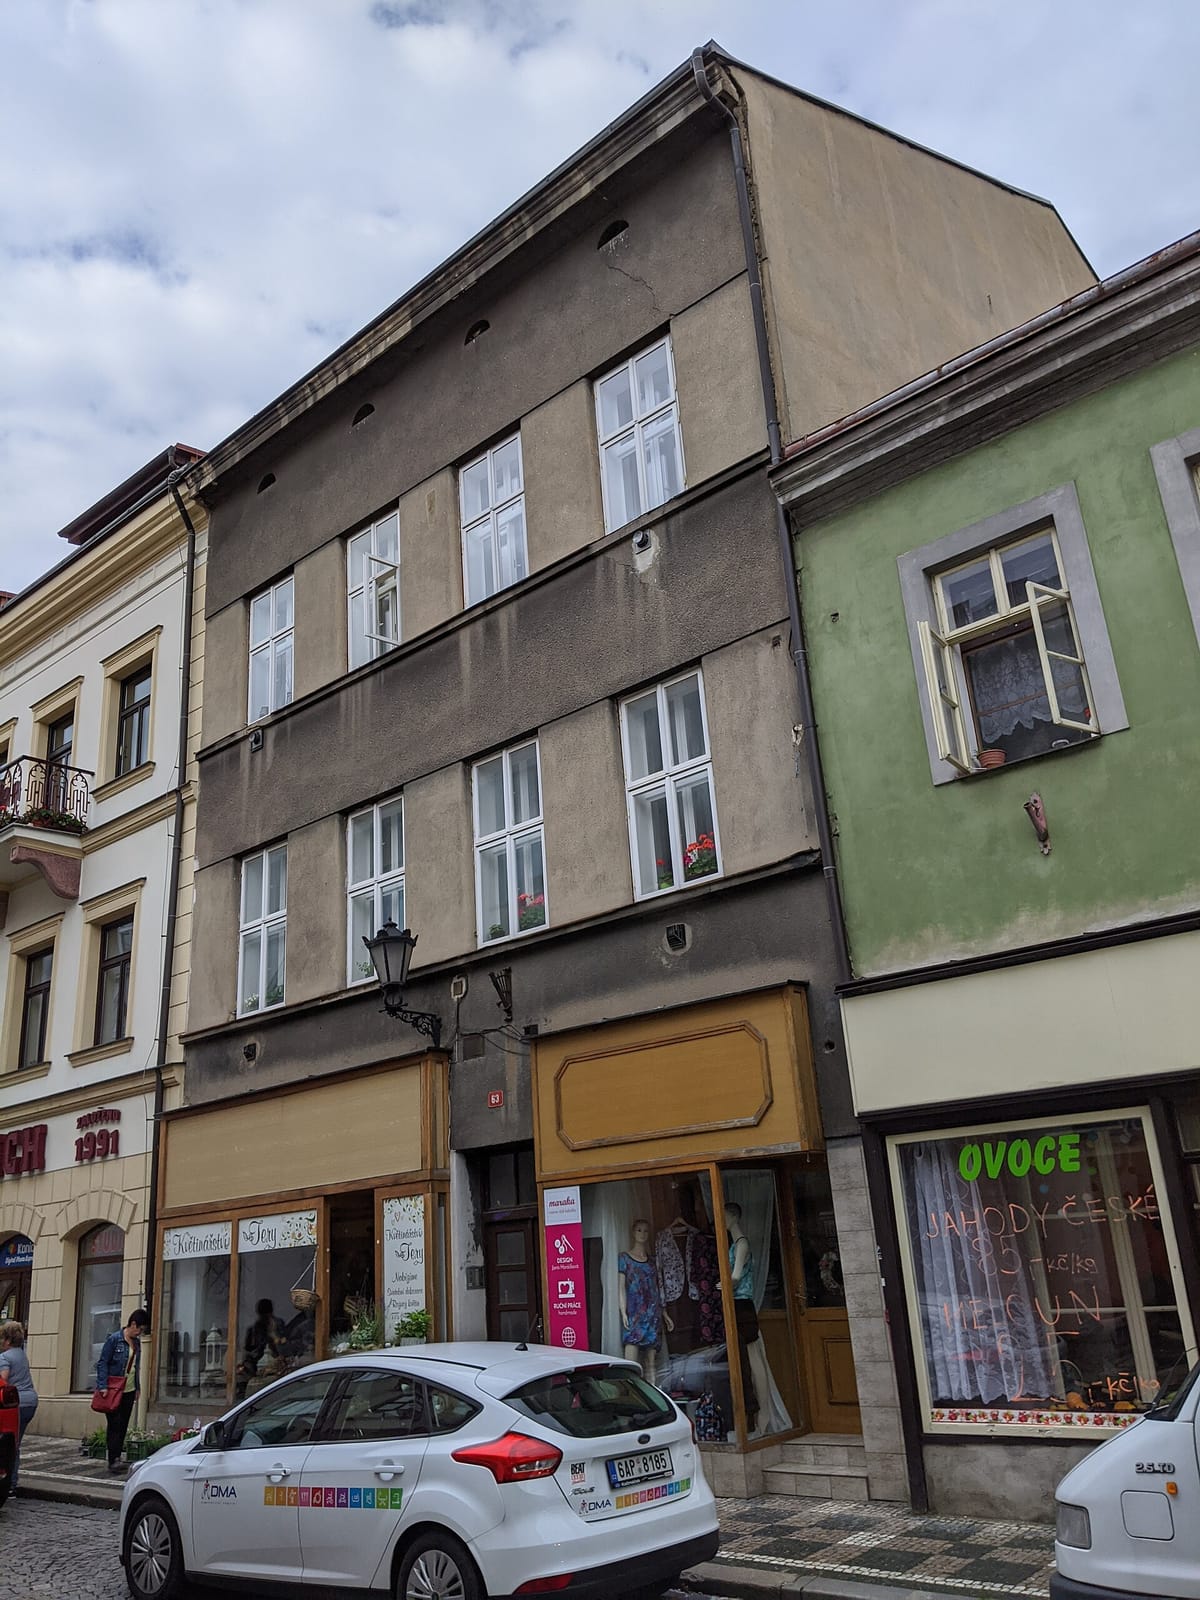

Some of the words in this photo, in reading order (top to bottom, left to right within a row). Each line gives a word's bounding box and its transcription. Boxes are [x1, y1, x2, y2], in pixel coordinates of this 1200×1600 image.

[75, 1129, 119, 1161] 1991
[959, 1133, 1081, 1181] OVOCE
[926, 1201, 1049, 1239] JAHODY
[1062, 1183, 1160, 1225] ČESKÉ
[173, 1231, 230, 1256] Květinářství
[242, 1220, 277, 1251] Tery
[395, 1242, 424, 1265] Tery
[570, 1462, 586, 1475] BEAT
[617, 1460, 635, 1478] 6AP
[643, 1452, 667, 1473] 8185
[1135, 1462, 1155, 1473] 2.5
[1157, 1462, 1175, 1474] TD
[210, 1485, 237, 1498] DMA
[588, 1499, 612, 1511] DMA
